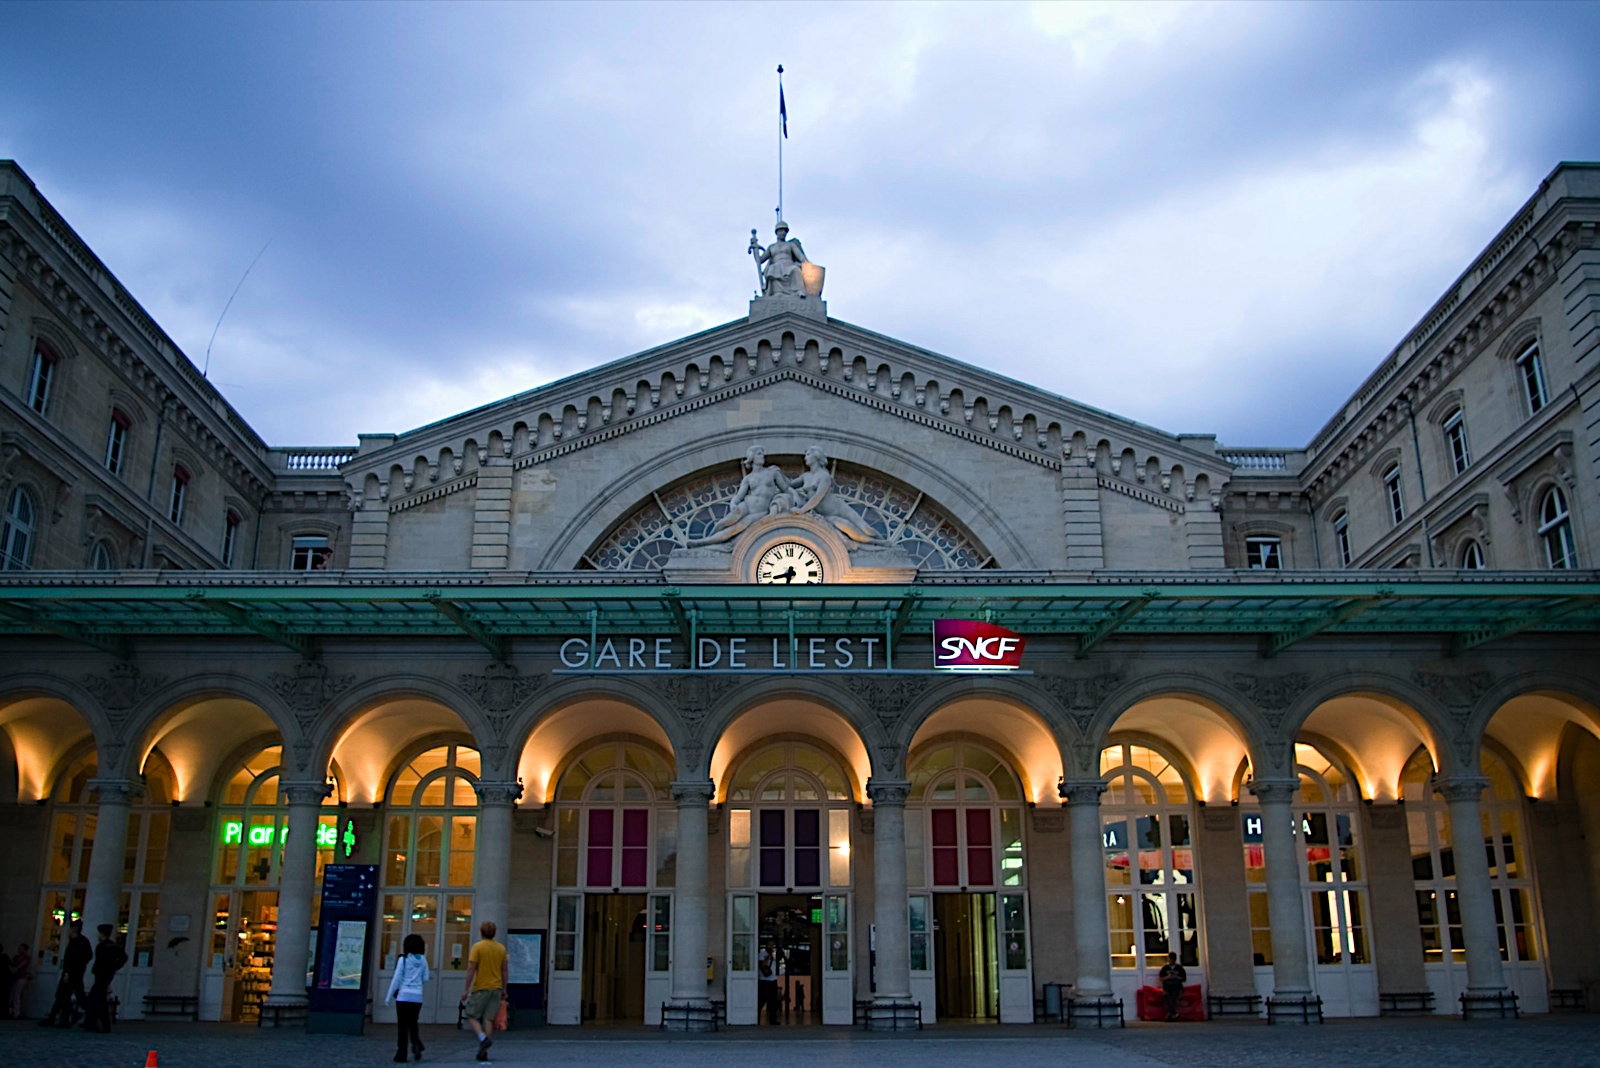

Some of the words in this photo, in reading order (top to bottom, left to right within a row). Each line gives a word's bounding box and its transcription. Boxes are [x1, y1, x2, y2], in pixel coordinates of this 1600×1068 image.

[762, 301, 817, 312] VERDUN
[559, 638, 672, 668] GARE
[698, 638, 746, 668] DE
[773, 638, 880, 668] L'EST
[938, 637, 1020, 660] SNCF
[224, 821, 338, 845] Parie
